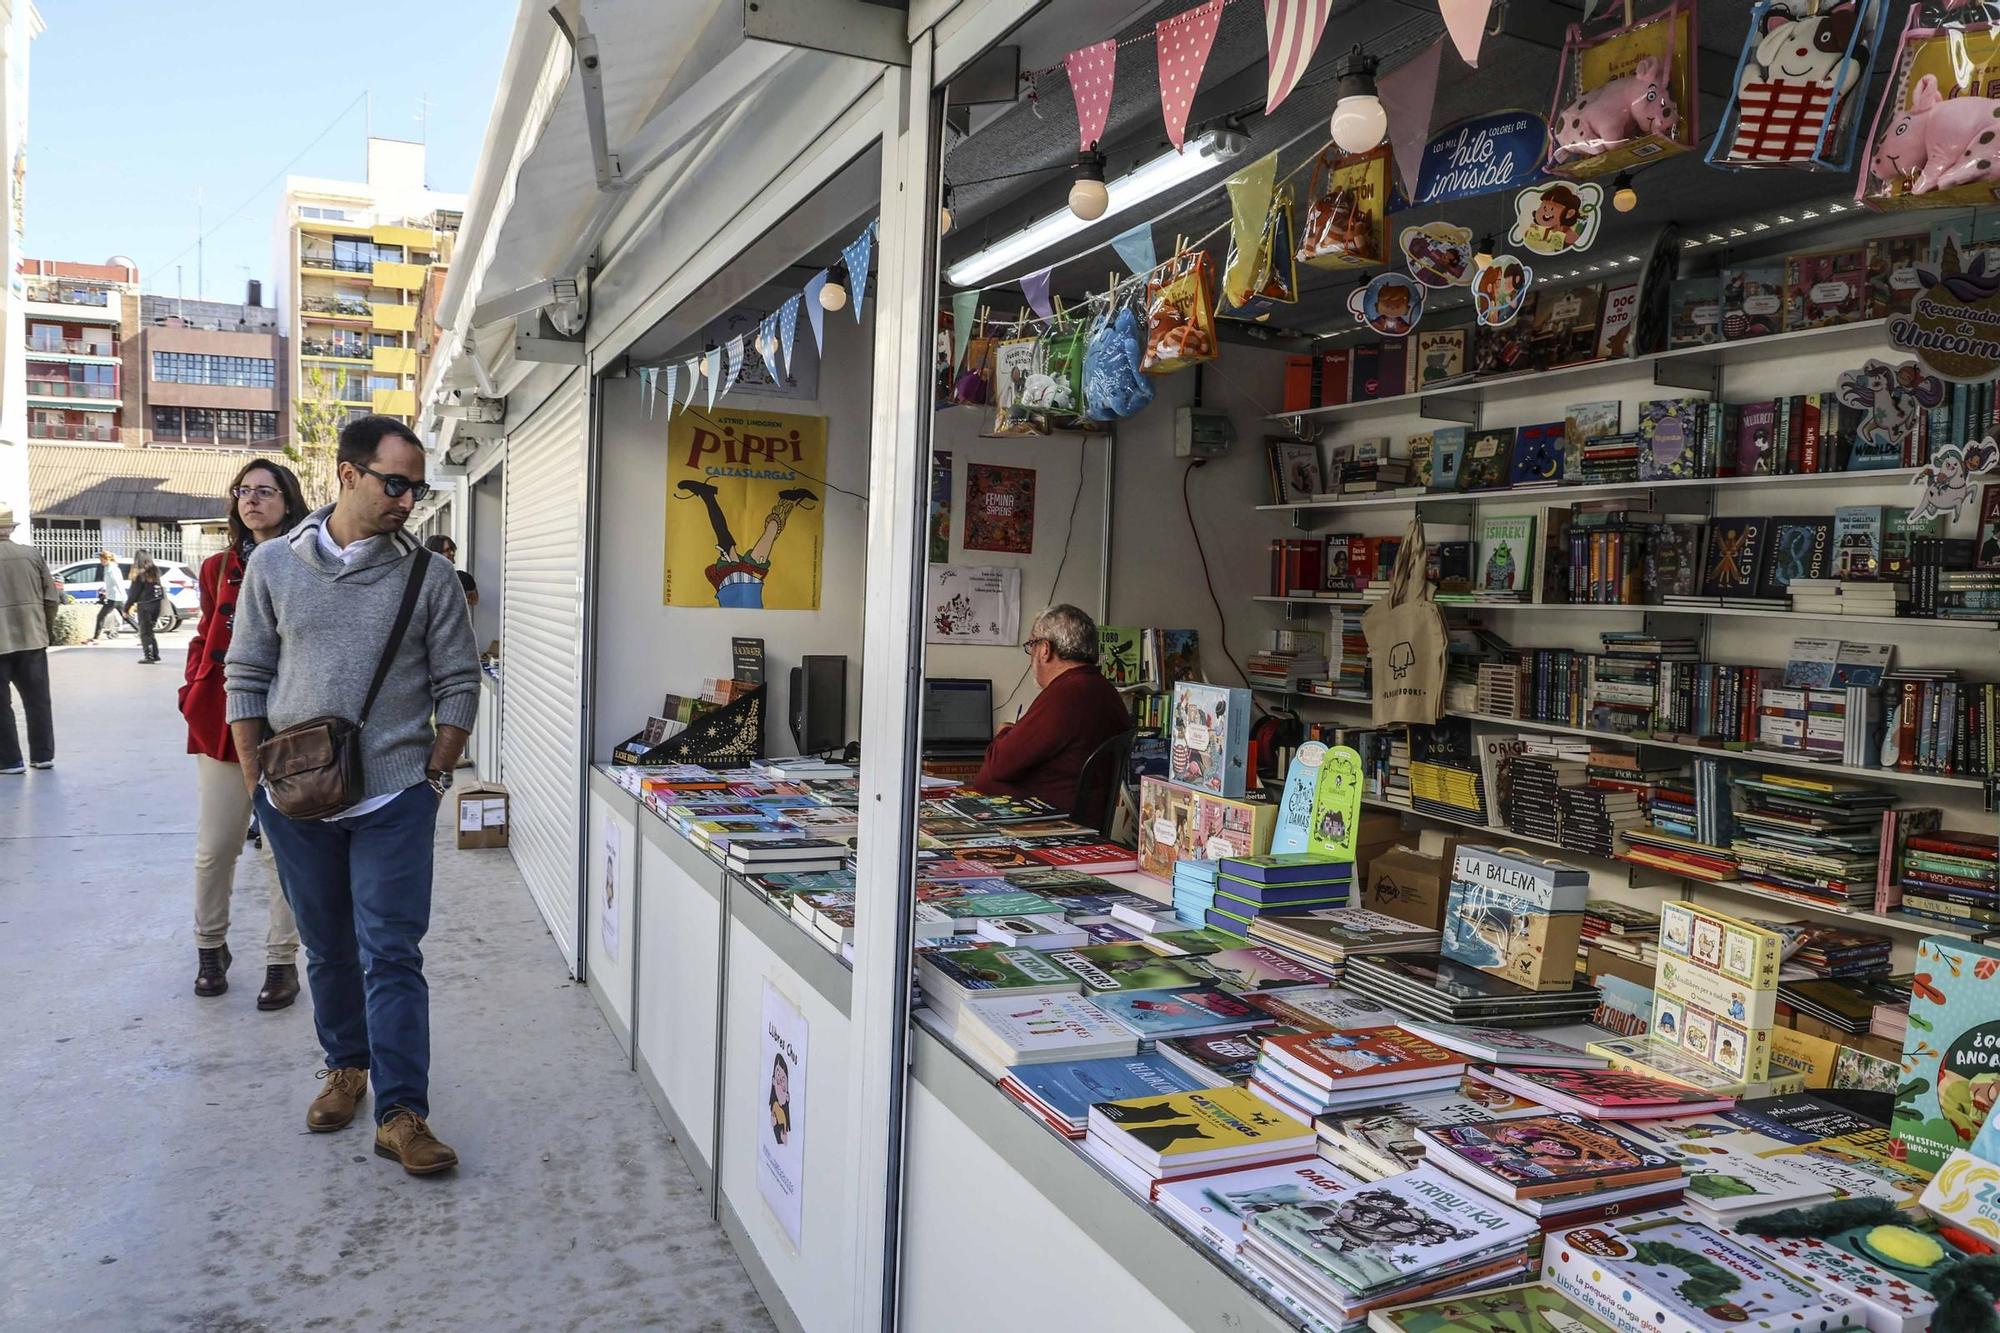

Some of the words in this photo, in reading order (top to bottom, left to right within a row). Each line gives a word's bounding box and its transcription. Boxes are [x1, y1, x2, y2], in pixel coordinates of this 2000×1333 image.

[1433, 144, 1444, 153] LOS
[1445, 138, 1457, 149] MIL
[1488, 123, 1515, 137] COLORES
[1516, 119, 1527, 131] DEL
[1449, 128, 1494, 169] hilo
[1423, 151, 1514, 203] invisible
[1613, 295, 1635, 308] DOC
[1606, 312, 1628, 324] SOTO
[1957, 323, 1973, 335] de
[1421, 336, 1463, 351] BABAR
[718, 417, 744, 425] ASTRID
[746, 419, 783, 428] LINDGREN
[705, 466, 797, 481] CALZASLARGAS
[985, 492, 1015, 507] FEMINA
[985, 505, 1012, 517] SAPIENS
[1739, 525, 1758, 585] EGIPTO
[1102, 632, 1119, 643] LOBO
[1427, 743, 1454, 753] NOG
[1466, 857, 1480, 876] LA
[1486, 863, 1536, 893] BALENA
[1015, 958, 1060, 979] TEMPS
[1068, 960, 1119, 988] COMER!
[1064, 1020, 1094, 1039] CERES
[1374, 1028, 1450, 1061] DAVID
[1188, 1094, 1261, 1137] CATWINGS
[1440, 1105, 1449, 1114] Y
[1929, 1148, 1940, 1158] DE
[1811, 1160, 1876, 1187] HOLA
[1404, 1177, 1416, 1187] LA
[1414, 1180, 1466, 1209] TRIBU
[1469, 1210, 1510, 1231] KAI
[1570, 1232, 1586, 1242] de
[1585, 1241, 1607, 1256] tela
[1579, 1229, 1593, 1240] Un
[1591, 1238, 1617, 1256] libro
[1686, 1226, 1701, 1235] La
[1700, 1234, 1764, 1270] pequeña
[1764, 1269, 1813, 1298] oruga
[1702, 1247, 1762, 1281] glotona
[1803, 1254, 1866, 1287] Dormilón
[1808, 1249, 1883, 1286] ZOZO
[1556, 1273, 1580, 1297] Libro
[1582, 1292, 1595, 1307] de
[1596, 1301, 1617, 1321] tela
[1575, 1273, 1584, 1286] La
[1584, 1282, 1616, 1307] pequeña
[1616, 1303, 1641, 1323] oruga
